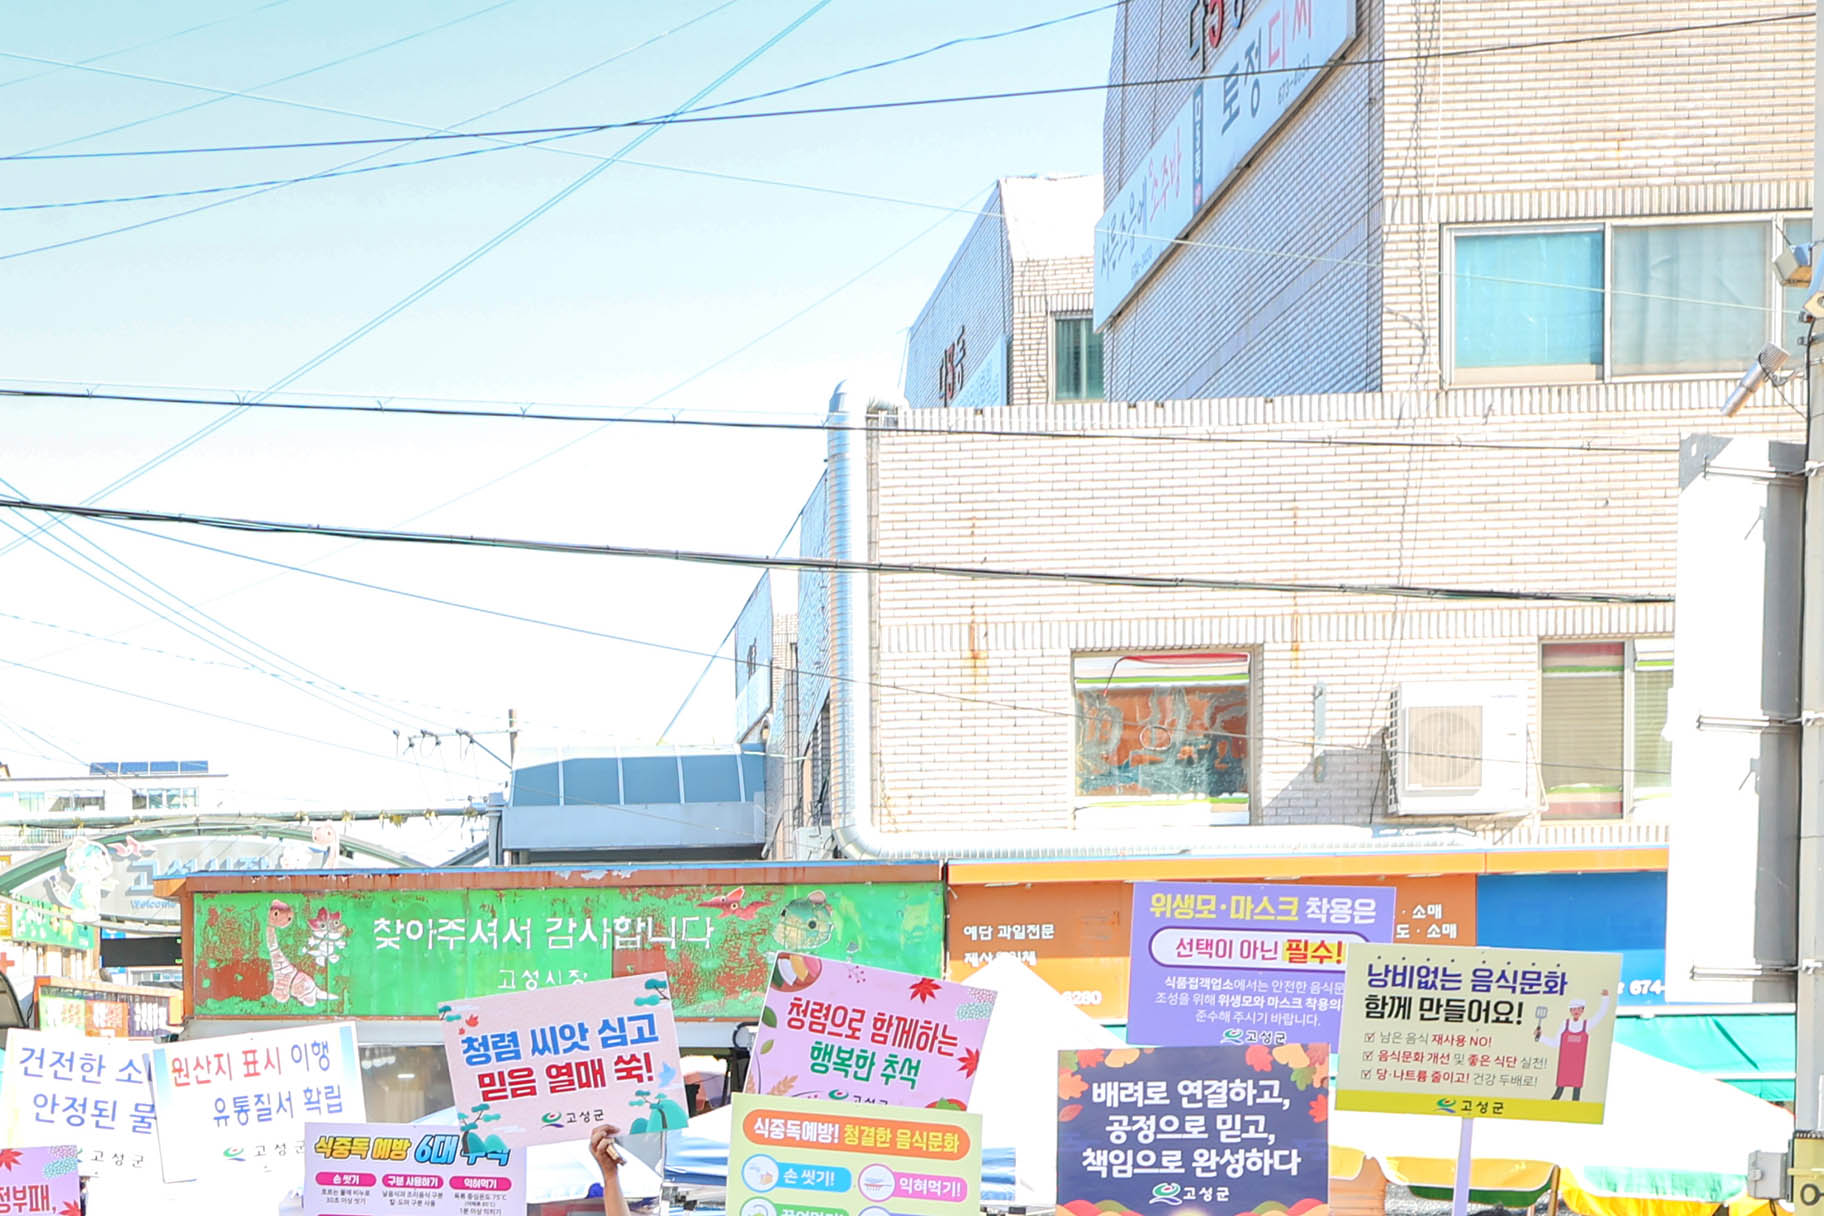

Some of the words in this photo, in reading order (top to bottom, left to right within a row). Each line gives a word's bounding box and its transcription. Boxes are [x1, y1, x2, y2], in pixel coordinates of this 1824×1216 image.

[1305, 896, 1377, 925] 착용은
[1412, 904, 1442, 919] 소매
[373, 916, 532, 950] 찾아주셔서
[545, 915, 716, 950] 감사합니다
[998, 924, 1055, 940] 과일전문
[1426, 924, 1457, 939] 소매
[1175, 937, 1234, 960] 선택이
[1239, 939, 1279, 961] 아닌
[1284, 939, 1343, 965] 필수!
[1164, 976, 1270, 993] 식품접객업소에서는
[1272, 979, 1307, 994] 안전한
[1367, 963, 1463, 993] 낭비없는
[1470, 967, 1569, 996] 음식문화
[1155, 992, 1190, 1007] 조성을
[1192, 993, 1216, 1007] 위해
[1218, 994, 1265, 1009] 위생모와
[1267, 996, 1303, 1010] 마스크
[1364, 994, 1412, 1021] 함께
[1419, 997, 1525, 1026] 만들어요!
[786, 996, 866, 1041] 청렴으로
[870, 1012, 959, 1058] 함께하는
[1195, 1009, 1231, 1023] 준수해
[1233, 1011, 1268, 1025] 주시기
[1271, 1012, 1321, 1027] 바랍니다.
[461, 1031, 522, 1067] 청렴
[530, 1022, 590, 1057] 씨앗
[598, 1013, 659, 1050] 심고
[1246, 1031, 1287, 1045] 고성군
[1379, 1032, 1403, 1044] 남은
[1405, 1033, 1429, 1045] 음식
[1431, 1033, 1467, 1047] 재사용
[1469, 1036, 1493, 1048] NO!
[18, 1046, 106, 1085] 건전한
[170, 1051, 233, 1088] 원산지
[241, 1046, 282, 1079] 표시
[290, 1040, 331, 1073] 이행
[810, 1040, 876, 1083] 행복한
[880, 1053, 922, 1090] 추석
[1377, 1050, 1425, 1063] 음식문화
[1427, 1052, 1451, 1064] 개선
[1468, 1054, 1491, 1067] 좋은
[1493, 1055, 1518, 1069] 식단
[477, 1066, 538, 1102] 믿음
[545, 1057, 607, 1094] 열매
[614, 1052, 654, 1084] 쑥!
[1431, 1070, 1470, 1084] 줄이고!
[1473, 1073, 1497, 1086] 건강
[1499, 1074, 1538, 1088] 두배로!
[212, 1090, 295, 1127] 유통질서
[303, 1084, 343, 1115] 확립
[1092, 1081, 1171, 1108] 배려로
[1177, 1078, 1291, 1110] 연결하고,
[1461, 1099, 1504, 1114] 고성군
[33, 1093, 117, 1131] 안정된
[566, 1109, 605, 1124] 고성군
[753, 1116, 840, 1144] 식중독예방!
[843, 1123, 891, 1148] 청결한
[896, 1128, 960, 1154] 음식문화
[1105, 1114, 1209, 1144] 공정으로
[1216, 1114, 1276, 1145] 믿고,
[90, 1150, 145, 1169] 고성군
[314, 1136, 370, 1159] 식중독
[371, 1136, 412, 1161] 예방
[414, 1134, 459, 1165] 6대
[1082, 1148, 1186, 1178] 책임으로
[1191, 1148, 1302, 1178] 완성하다
[783, 1168, 799, 1185] 손
[801, 1169, 835, 1187] 씻기!
[899, 1177, 962, 1198] 익혀먹기!
[1183, 1187, 1230, 1202] 고성군
